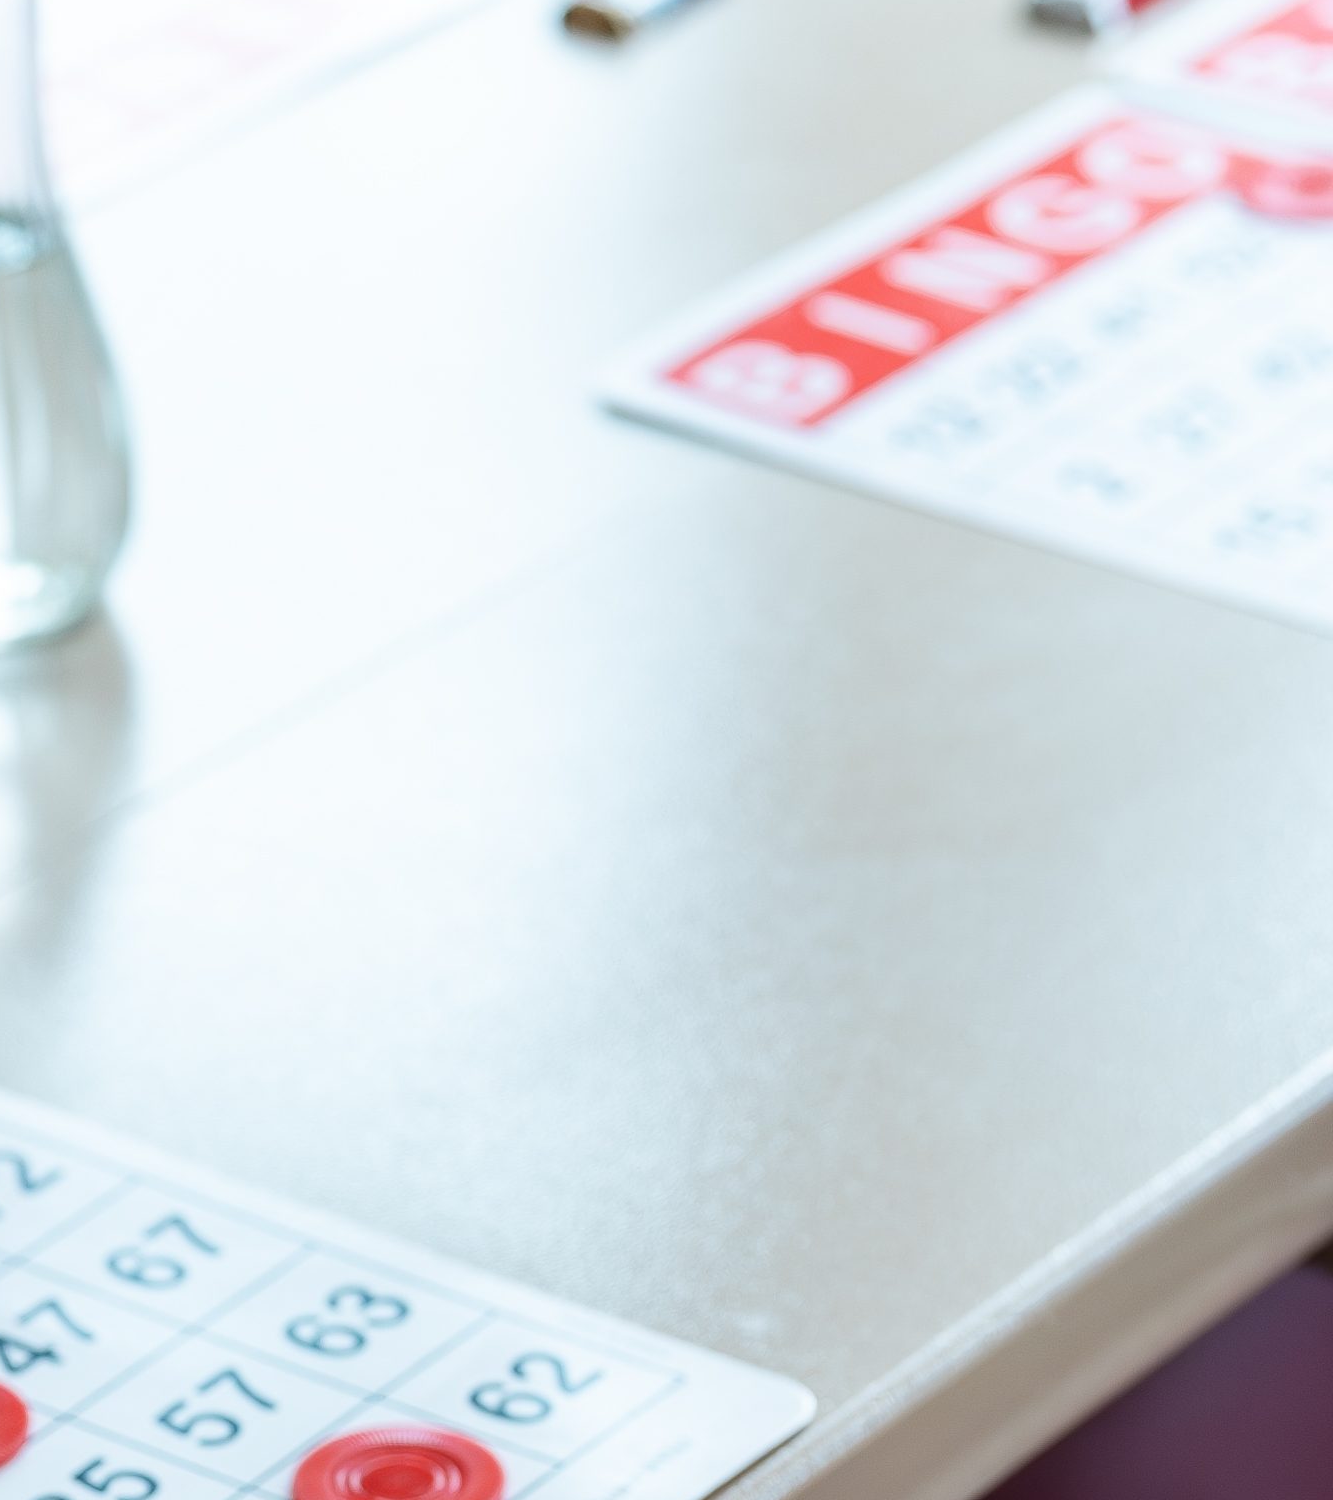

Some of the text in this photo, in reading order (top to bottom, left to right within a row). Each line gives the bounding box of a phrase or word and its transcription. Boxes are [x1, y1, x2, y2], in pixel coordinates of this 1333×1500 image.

[102, 1211, 227, 1293] 67
[156, 1364, 283, 1450] 57
[283, 1281, 412, 1360] 63
[468, 1347, 605, 1428] 62
